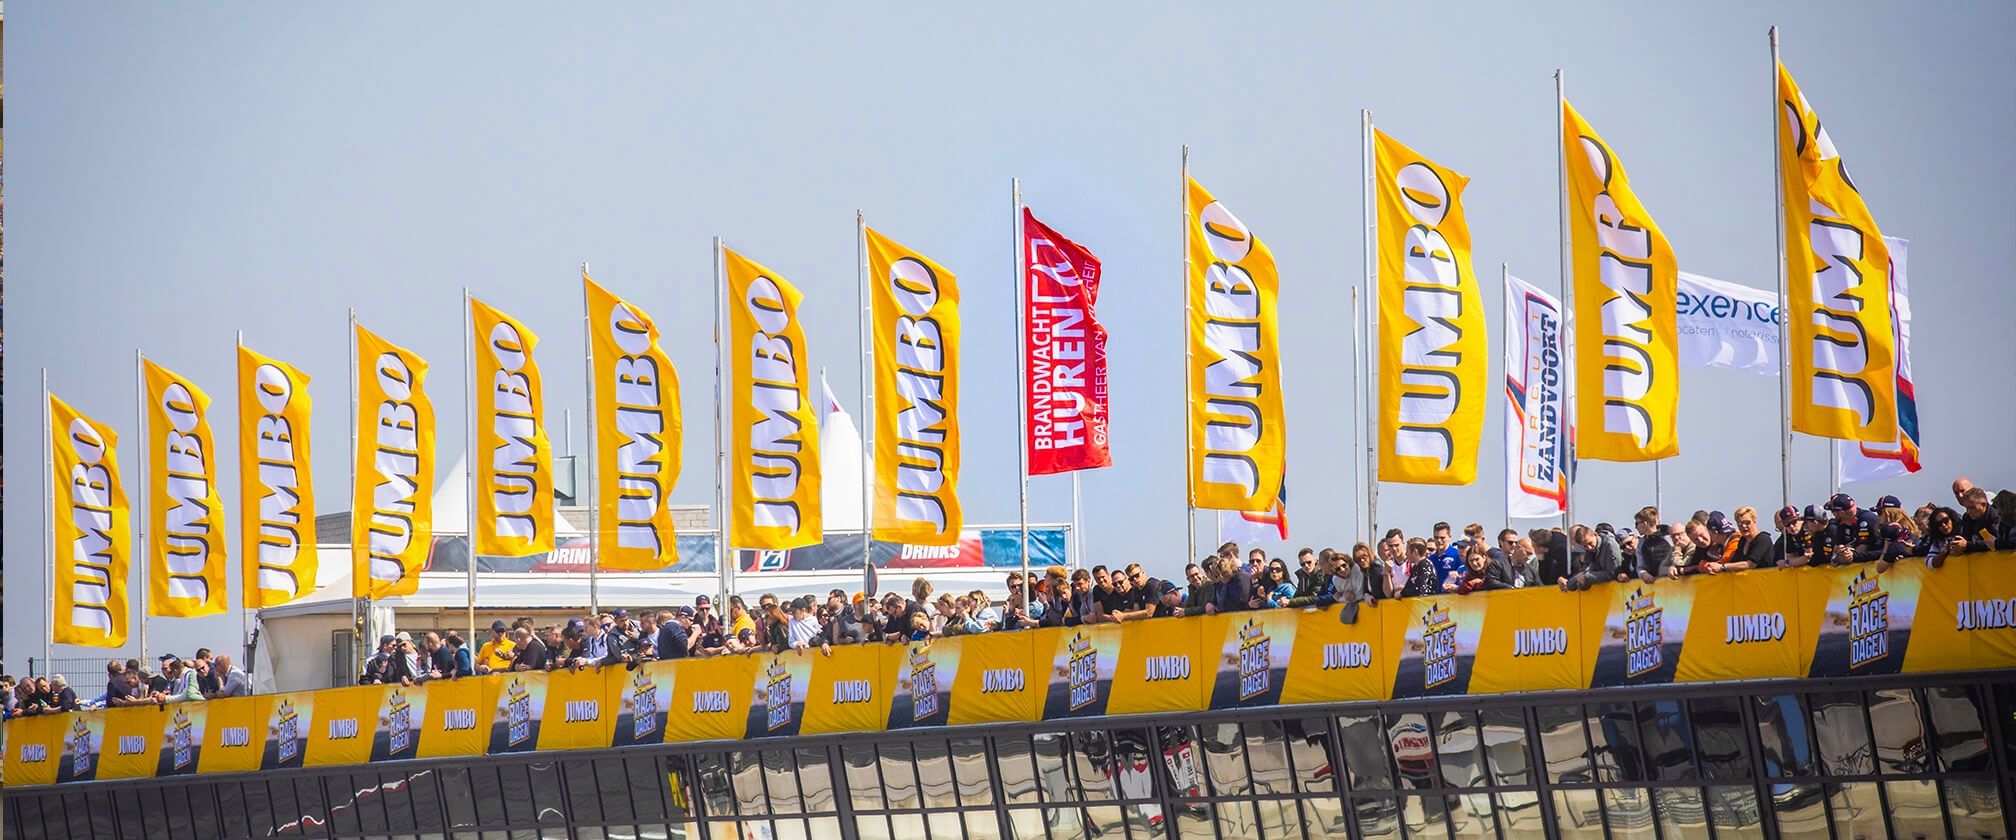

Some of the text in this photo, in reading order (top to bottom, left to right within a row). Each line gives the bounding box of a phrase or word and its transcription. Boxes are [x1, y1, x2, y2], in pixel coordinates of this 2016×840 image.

[1395, 161, 1462, 471] JUMBO
[1200, 200, 1263, 499] JUMBO
[1031, 306, 1053, 450] BRANDWACHT
[1051, 308, 1086, 449] HUREN
[1093, 330, 1107, 445] GASTHEER VAN
[1527, 310, 1541, 478] CIRCUIT
[745, 275, 802, 537] JUMBO
[889, 256, 947, 535] JUMBO
[1538, 313, 1560, 483] ZANDVOORT
[490, 321, 537, 545] JUMBO
[610, 301, 664, 559] JUMBO
[255, 363, 300, 598] JUMBO
[369, 352, 419, 585] JUMBO
[162, 382, 210, 607] JUMBO
[69, 417, 113, 638] JUMBO
[547, 547, 598, 564] DRIN
[901, 544, 960, 560] DRINKS
[1628, 611, 1662, 650] RACE
[1725, 613, 1786, 645] JUMBO
[1851, 596, 1887, 638] RACE
[1241, 640, 1269, 675] RACE
[1322, 642, 1371, 670] JUMBO
[1424, 626, 1456, 662] RACE
[1512, 627, 1568, 657] JUMBO
[1852, 631, 1886, 664] DAGEN
[1070, 653, 1097, 686] RACE
[1144, 654, 1190, 681] JUMBO
[1427, 656, 1455, 685] DAGEN
[1630, 645, 1660, 673] DAGEN
[768, 677, 791, 709] RACE
[833, 679, 872, 704] JUMBO
[912, 667, 936, 698] RACE
[981, 667, 1025, 693] JUMBO
[1071, 682, 1096, 707] DAGEN
[1242, 670, 1268, 696] DAGEN
[510, 695, 530, 727] RACE
[564, 700, 600, 723] JUMBO
[634, 687, 656, 717] RACE
[693, 690, 731, 713] JUMBO
[769, 704, 790, 727] DAGEN
[914, 693, 937, 718] DAGEN
[328, 718, 359, 740] JUMBO
[444, 708, 477, 731] JUMBO
[118, 735, 146, 755] JUMBO
[221, 727, 249, 748] JUMBO
